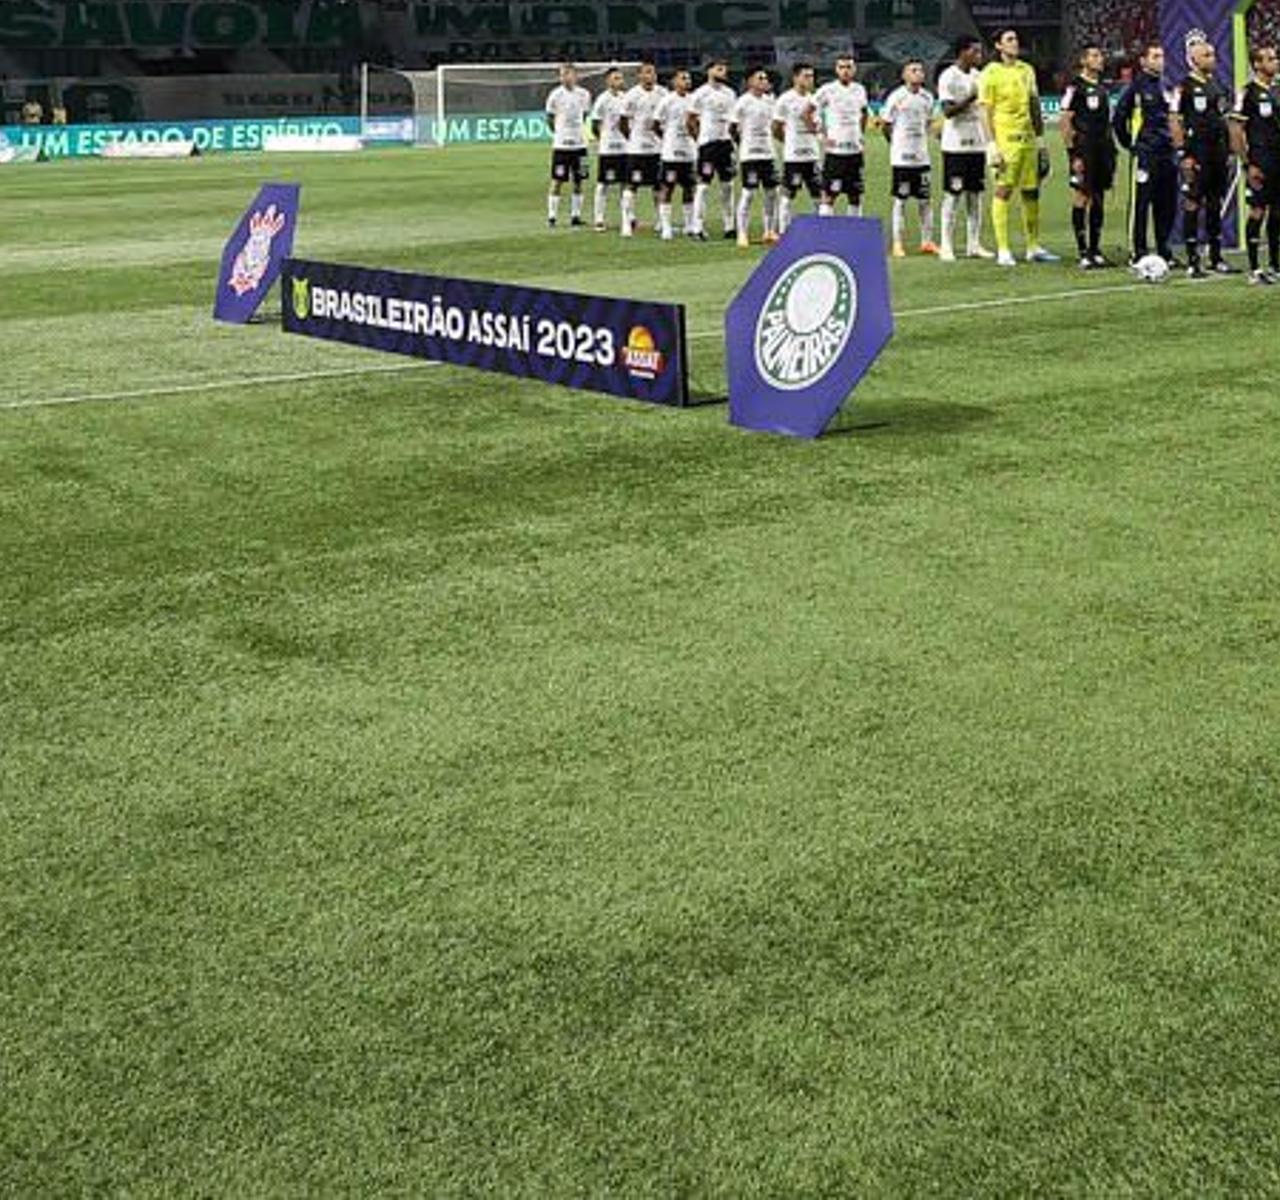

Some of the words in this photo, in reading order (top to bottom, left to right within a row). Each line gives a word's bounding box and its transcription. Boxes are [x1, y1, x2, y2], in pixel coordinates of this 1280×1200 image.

[193, 126, 226, 150] DE
[312, 286, 464, 340] BRASILEIRÃO
[536, 319, 614, 366] 2023
